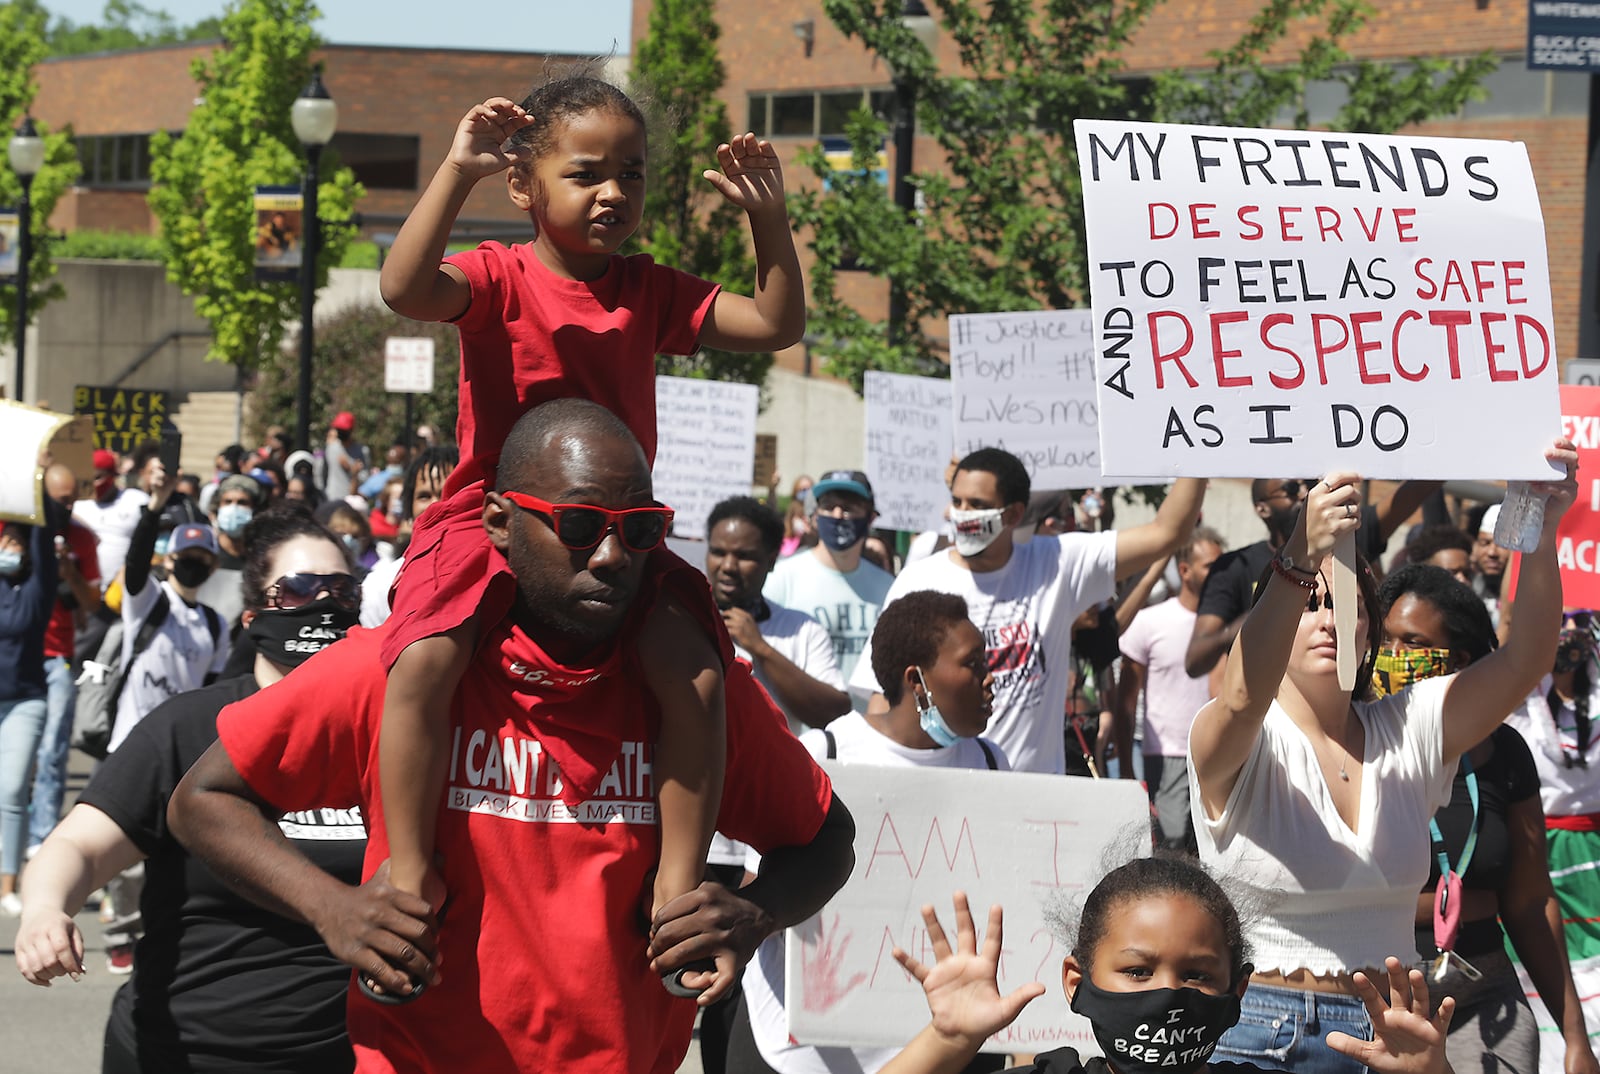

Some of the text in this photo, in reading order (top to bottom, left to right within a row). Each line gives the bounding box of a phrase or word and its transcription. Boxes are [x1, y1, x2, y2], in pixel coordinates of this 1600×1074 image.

[1089, 132, 1499, 201] MY FRIENDS
[1148, 202, 1419, 242] DESERVE
[1100, 257, 1527, 304] TO FEEL AS SAFE
[1103, 307, 1134, 400] AND
[1148, 309, 1550, 390] RESPECTED
[74, 385, 166, 413] BLACK
[93, 411, 164, 440] IVES
[1162, 404, 1409, 451] AS I DO
[320, 613, 334, 625] I
[814, 604, 880, 632] OHI
[450, 726, 462, 782] I
[454, 791, 519, 815] BLACK
[524, 802, 579, 819] LIVES
[865, 812, 1084, 888] AM I
[1166, 1008, 1184, 1024] I
[1134, 1023, 1206, 1046] CAN'T
[1114, 1040, 1215, 1067] BREATHE
